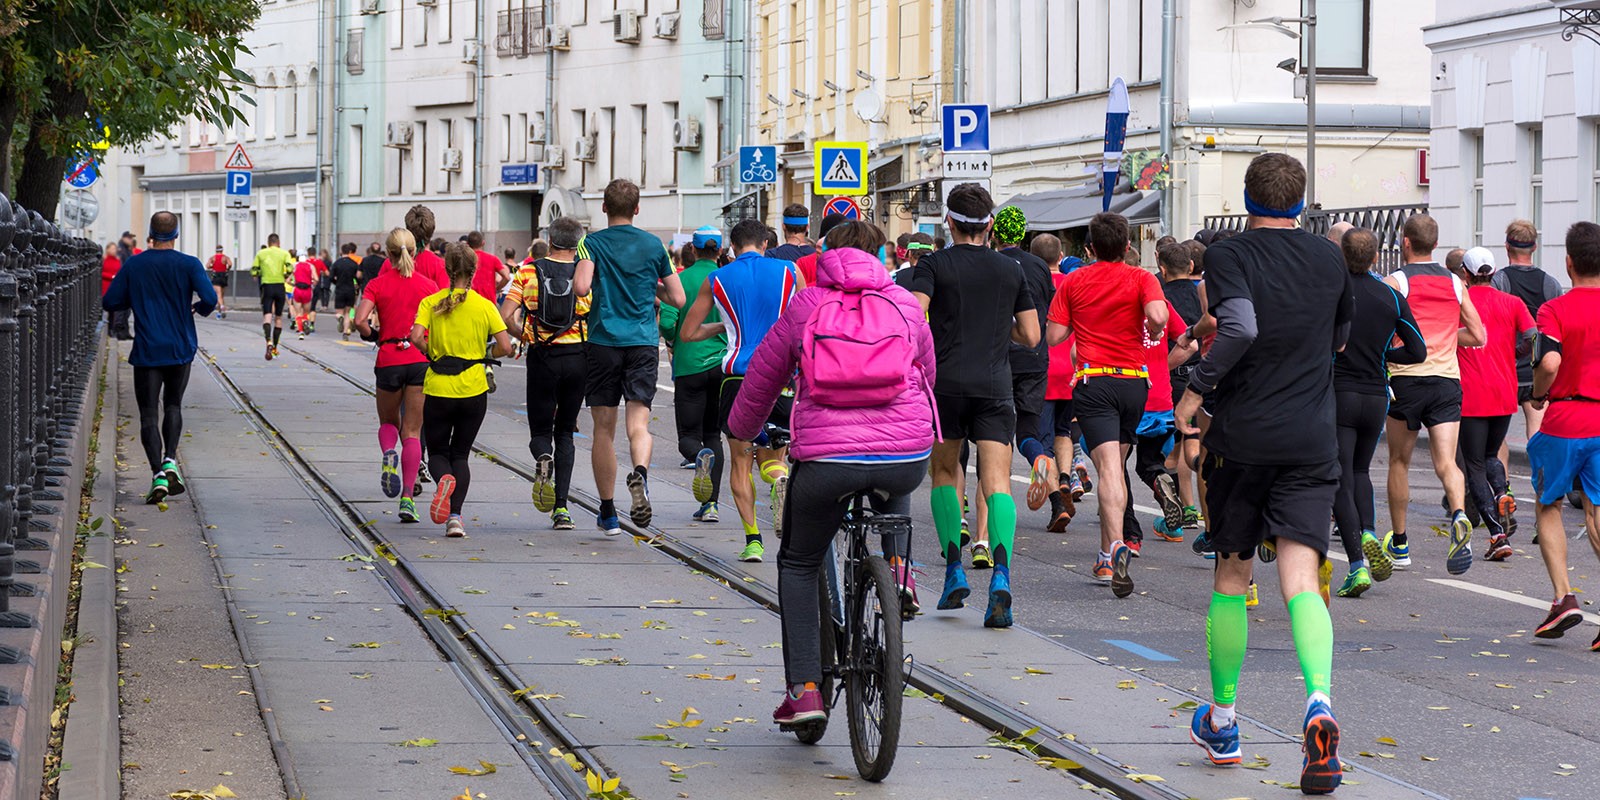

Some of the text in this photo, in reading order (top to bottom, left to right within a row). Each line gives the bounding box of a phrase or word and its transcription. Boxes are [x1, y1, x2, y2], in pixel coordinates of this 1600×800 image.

[953, 109, 978, 148] P
[956, 161, 967, 170] 11
[232, 173, 248, 193] P
